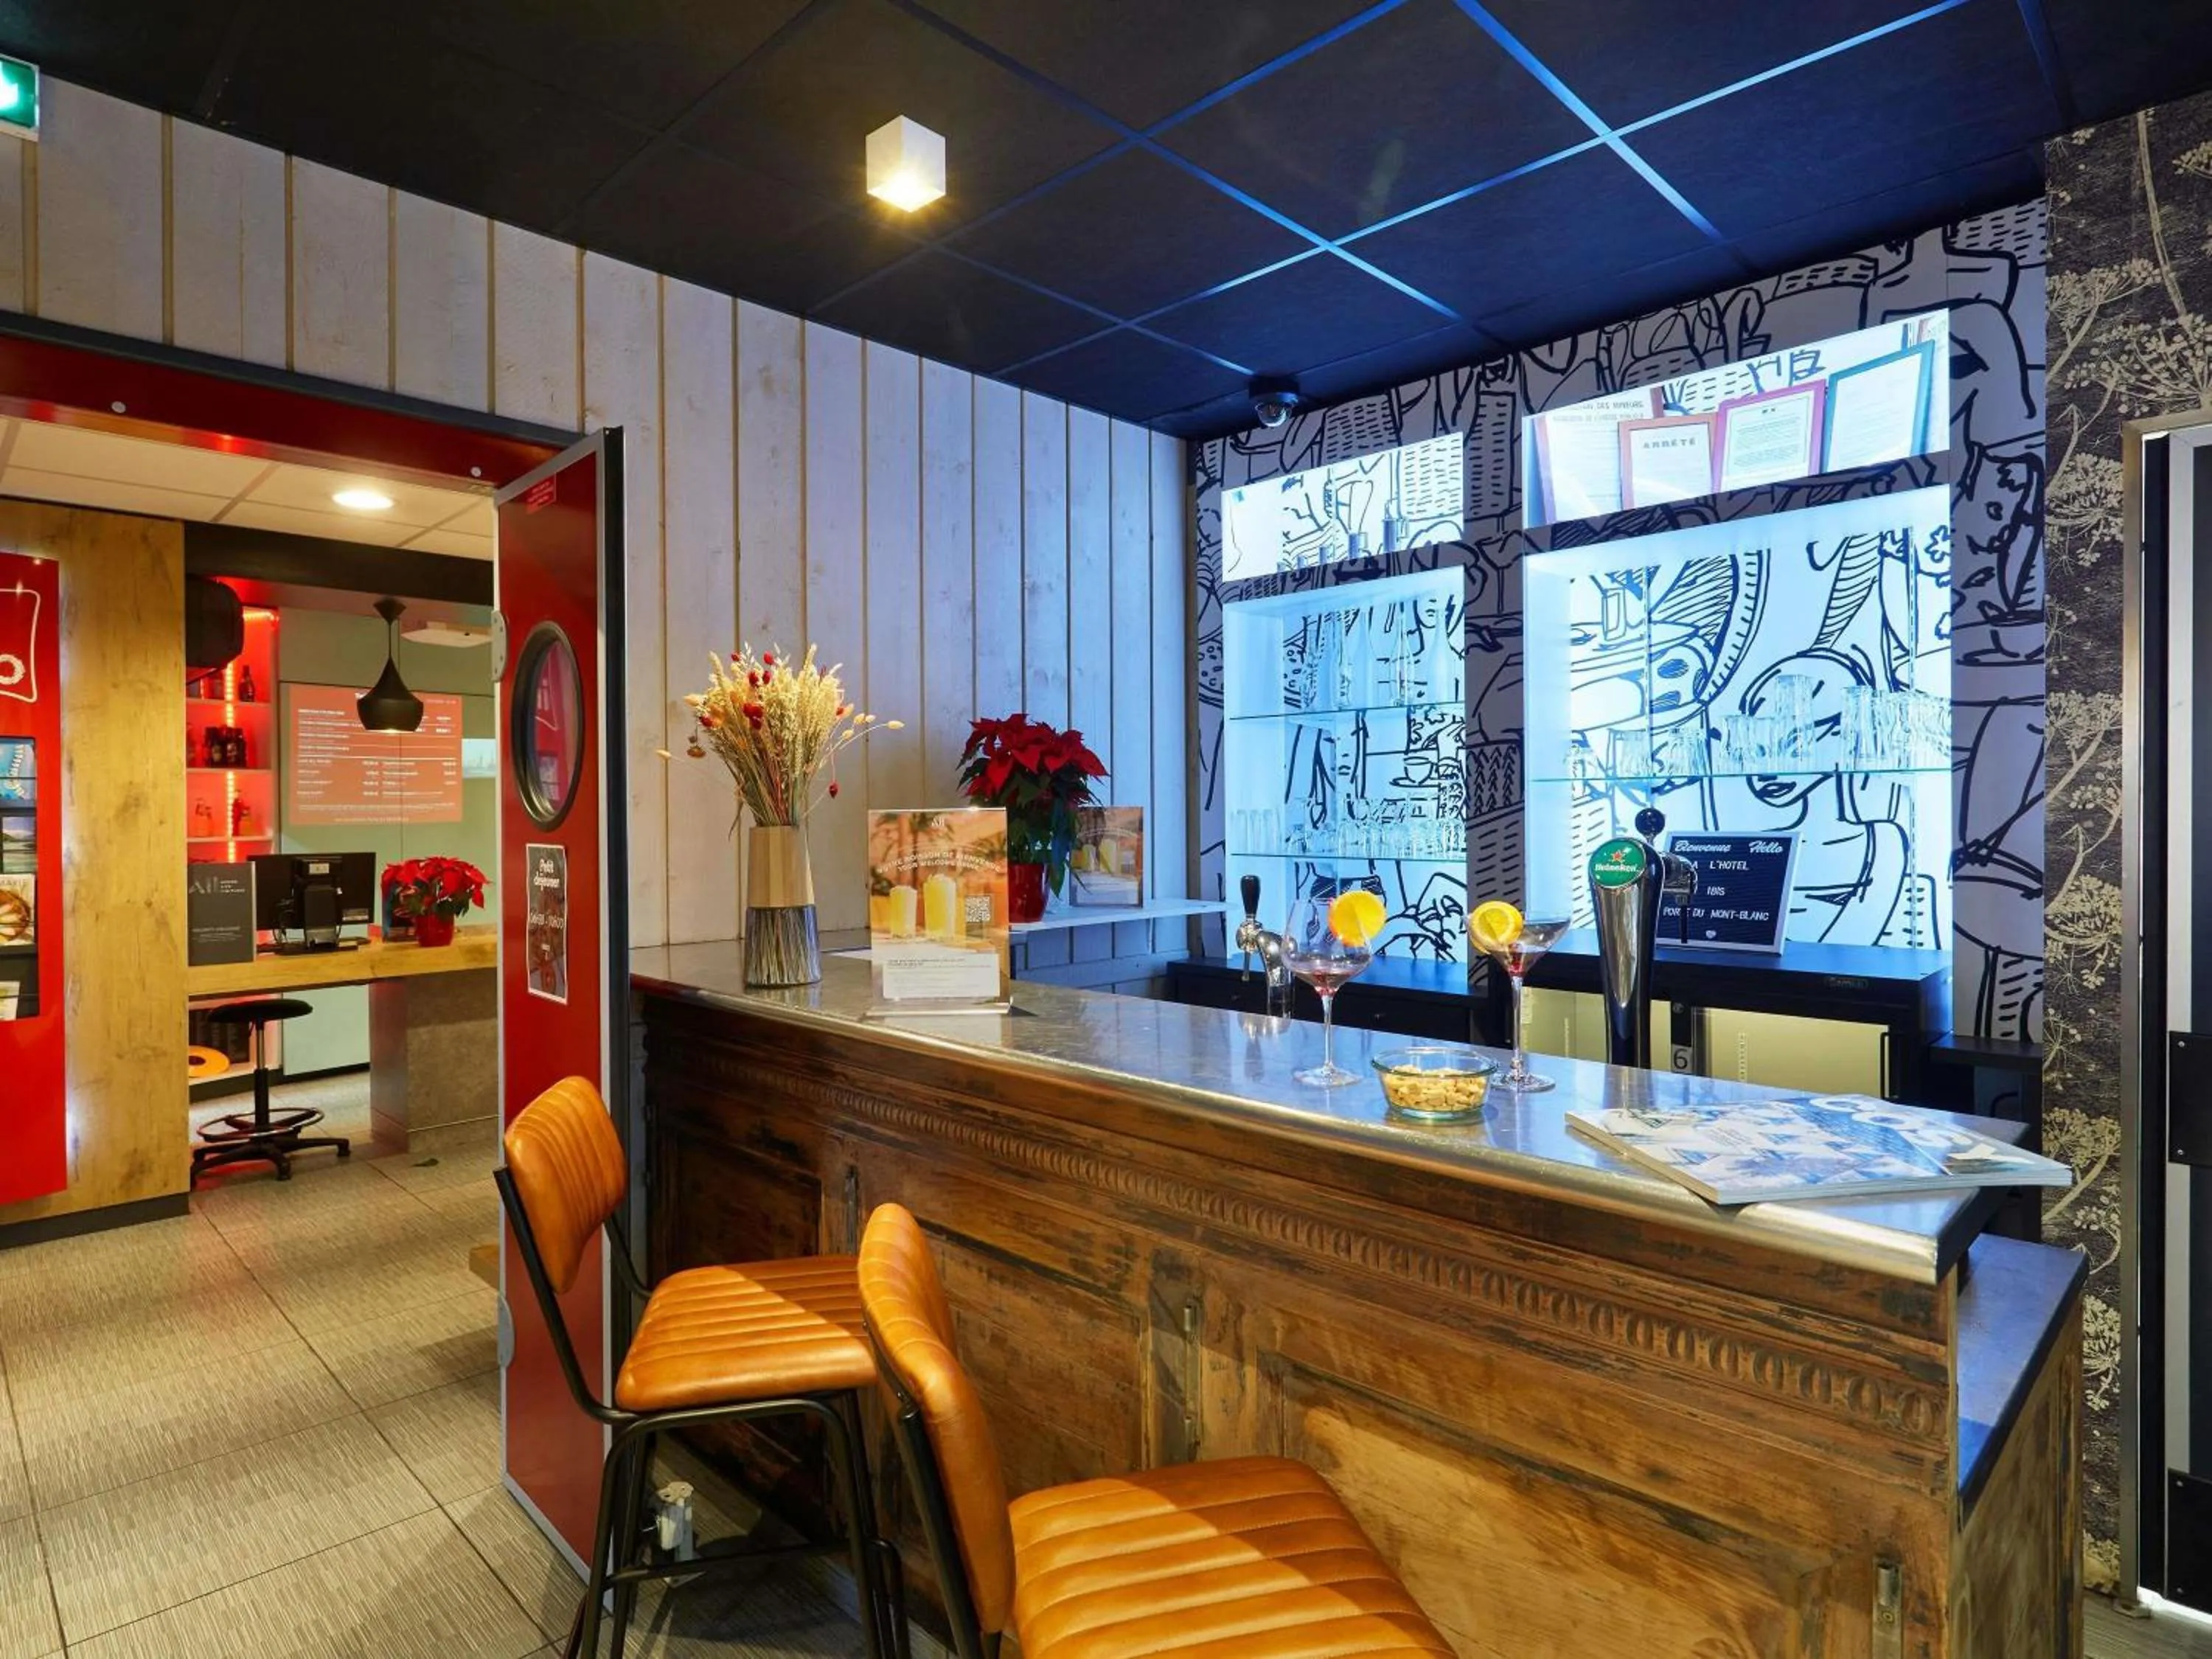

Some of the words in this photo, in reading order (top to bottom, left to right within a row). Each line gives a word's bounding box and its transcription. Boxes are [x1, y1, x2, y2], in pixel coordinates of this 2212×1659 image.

[1748, 840, 1784, 853] Hello
[1707, 886, 1726, 896] IBIS
[1692, 908, 1705, 918] DU
[1711, 908, 1770, 921] MONT-BLANC
[1673, 1048, 1688, 1070] 6
